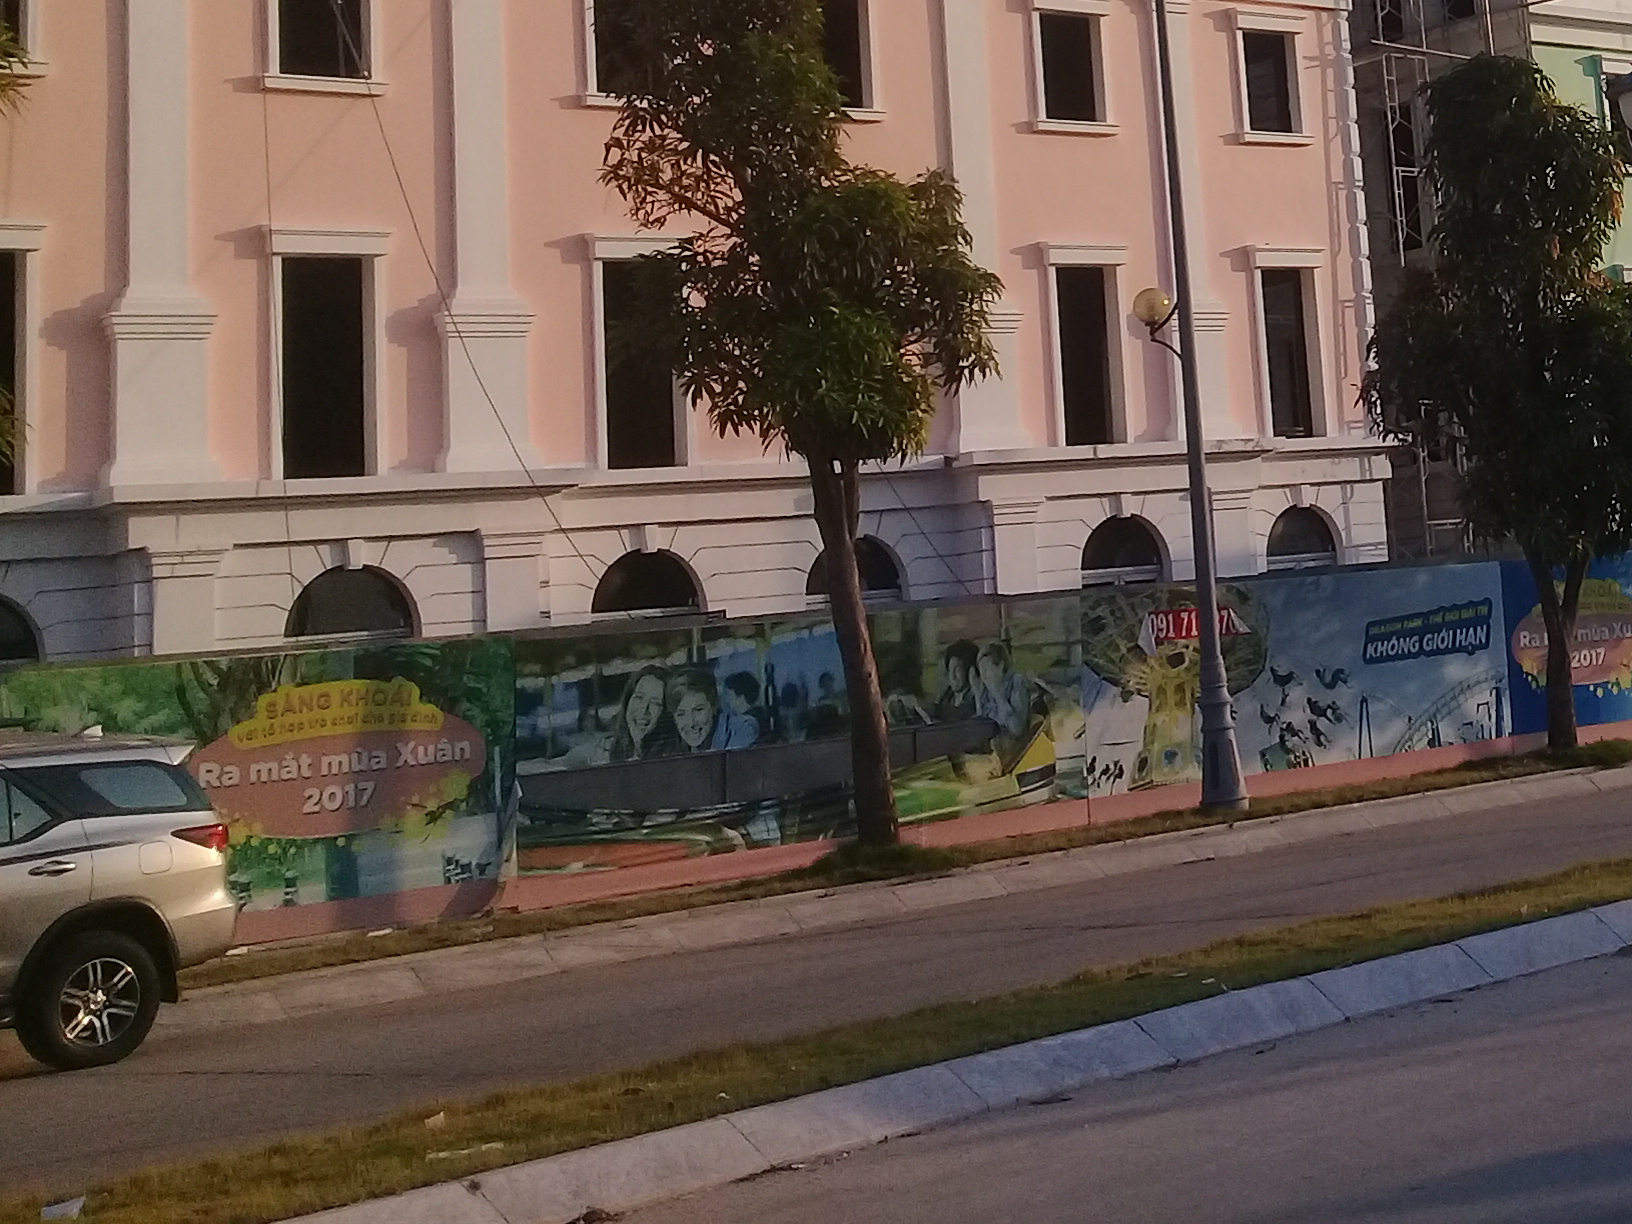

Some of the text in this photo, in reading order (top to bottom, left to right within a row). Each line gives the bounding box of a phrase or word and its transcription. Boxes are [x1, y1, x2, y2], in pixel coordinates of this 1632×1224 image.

[1367, 635, 1419, 659] KHÔNG
[1456, 624, 1487, 651] HẠN
[1520, 631, 1540, 648] Ra
[1571, 647, 1606, 668] 2017
[200, 737, 471, 789] Ra mắt mùa Xuân
[302, 781, 375, 815] 2017
